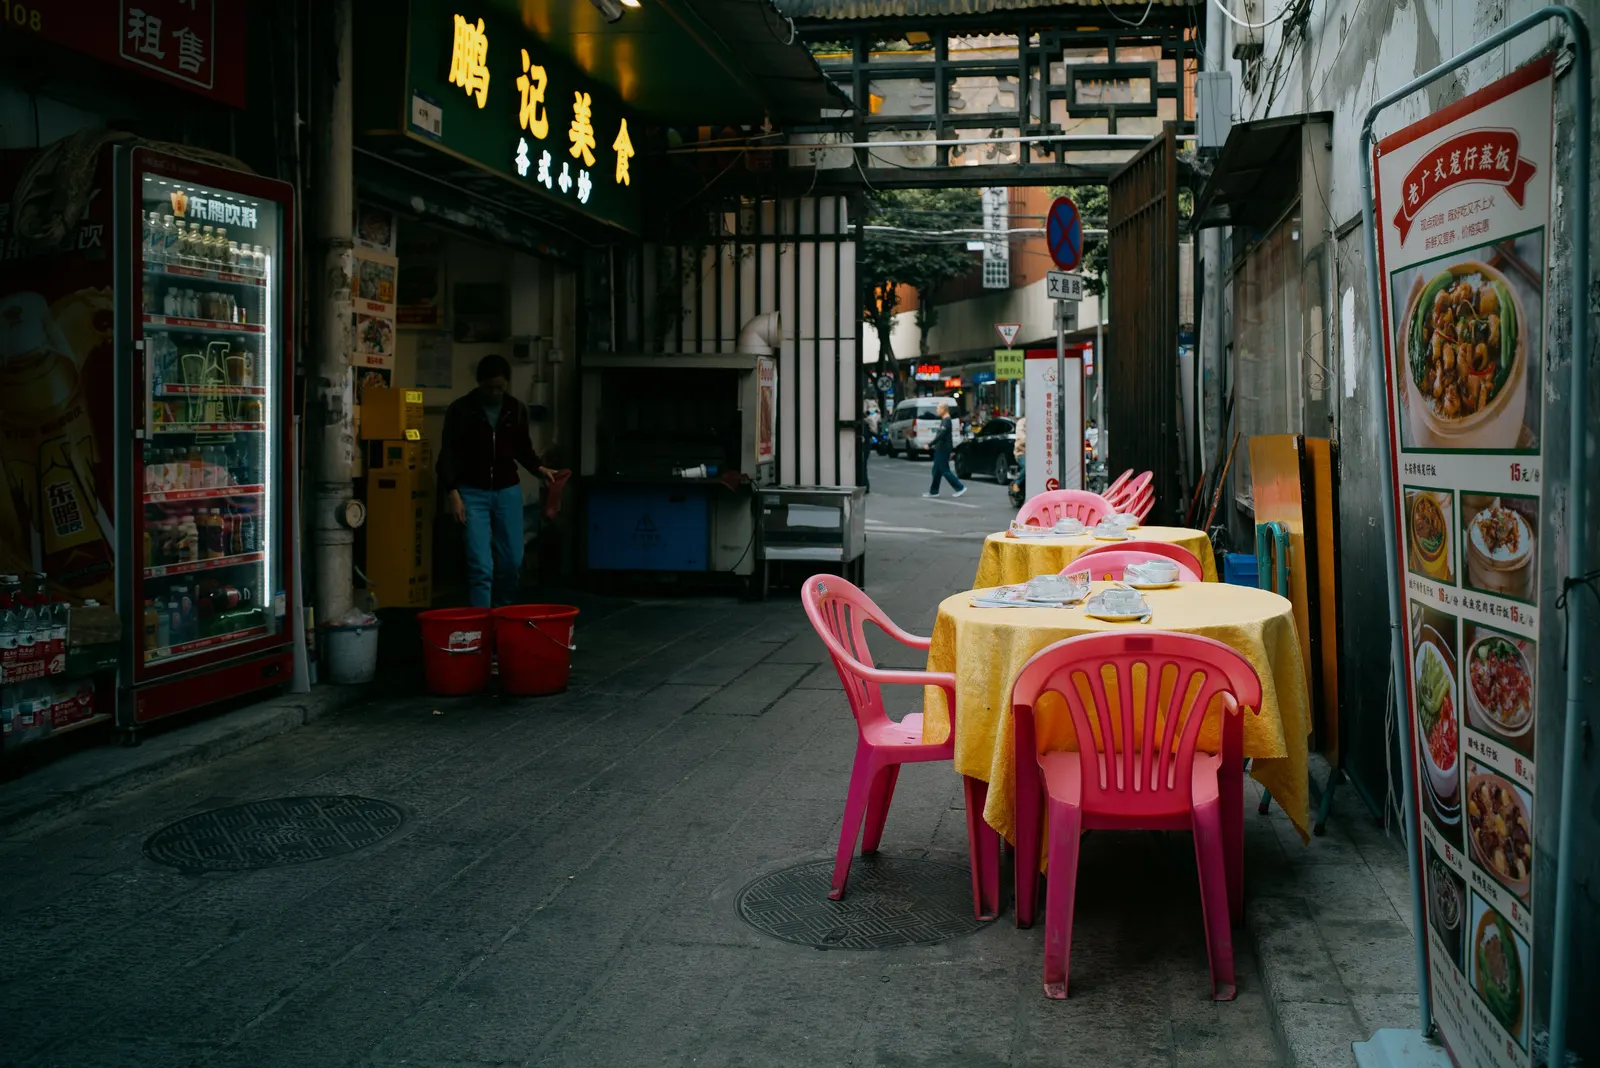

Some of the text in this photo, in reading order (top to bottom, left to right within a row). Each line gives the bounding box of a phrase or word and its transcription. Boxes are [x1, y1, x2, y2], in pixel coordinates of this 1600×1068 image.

[128, 8, 206, 74] 租售
[449, 14, 634, 186] 鹏记美食
[515, 137, 592, 204] 各式小炒
[1408, 143, 1510, 207] 老广式笼仔蒸饭
[190, 195, 258, 229] 东鹏饮料
[1050, 277, 1081, 297] 文昌路
[1003, 327, 1013, 336] 让
